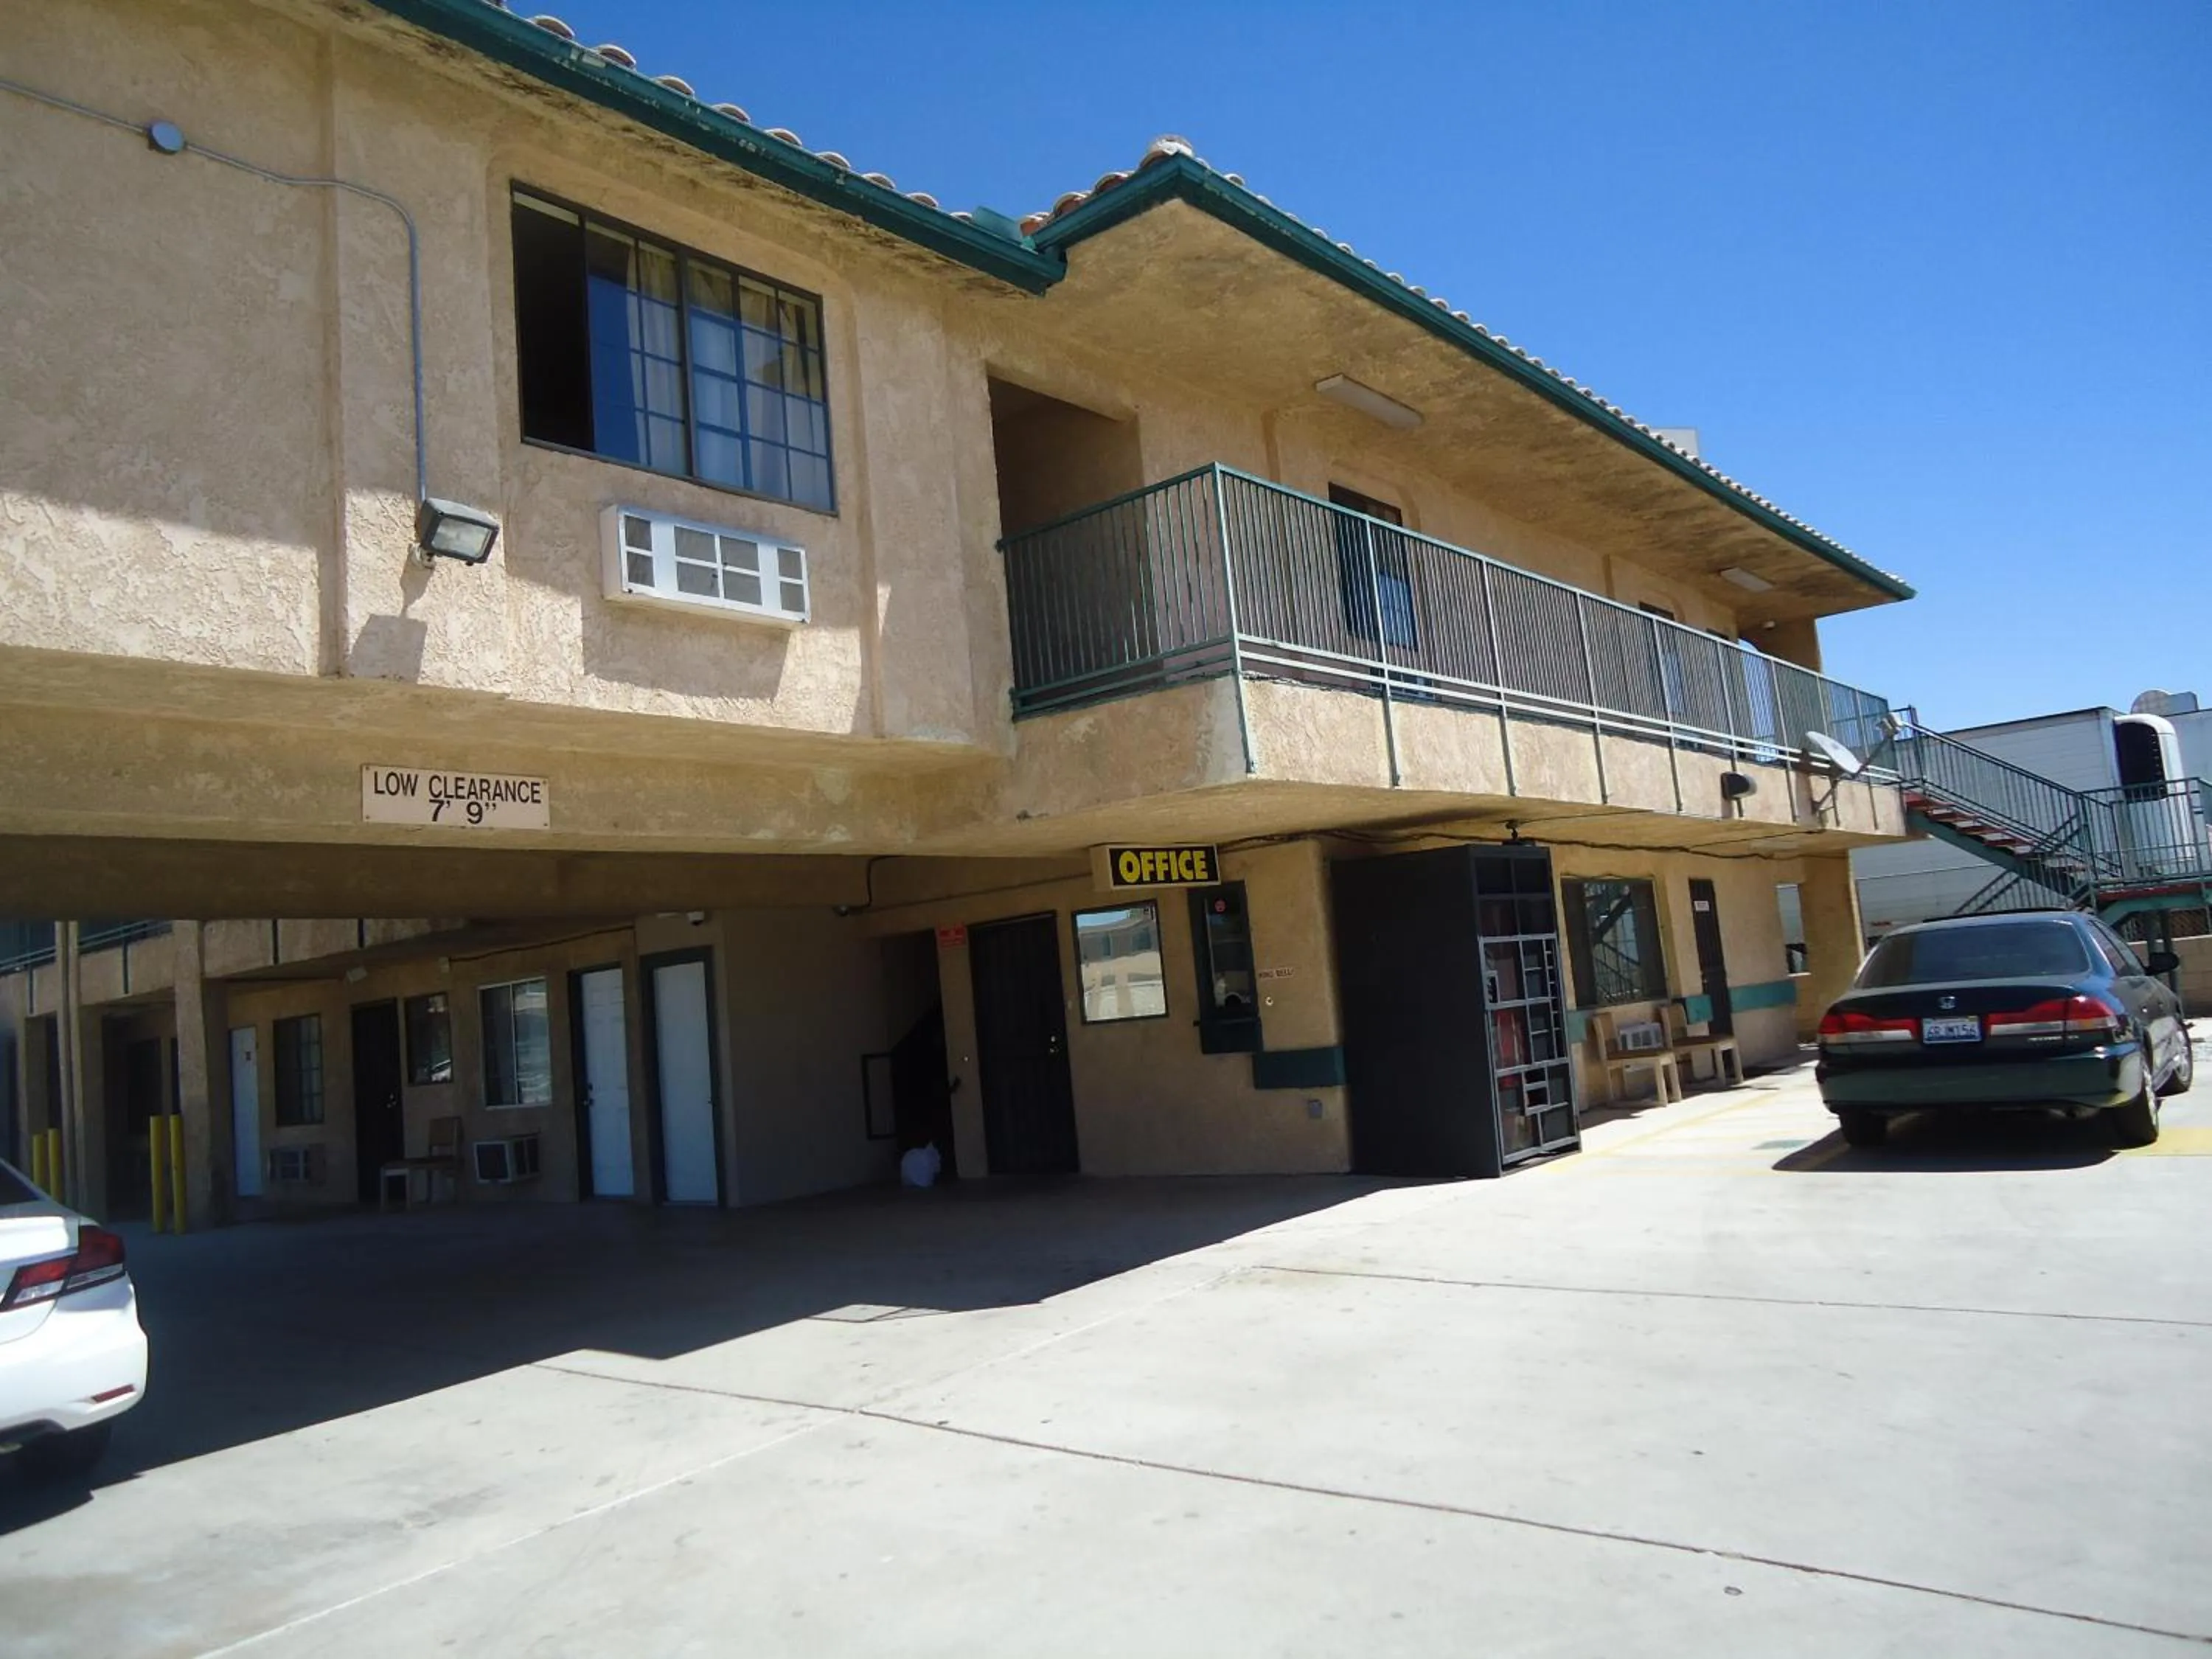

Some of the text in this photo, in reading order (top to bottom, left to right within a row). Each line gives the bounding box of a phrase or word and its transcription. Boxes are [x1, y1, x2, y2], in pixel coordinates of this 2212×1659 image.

[373, 771, 542, 804] LOW CLEARANCE
[1119, 850, 1208, 883] OFFICE
